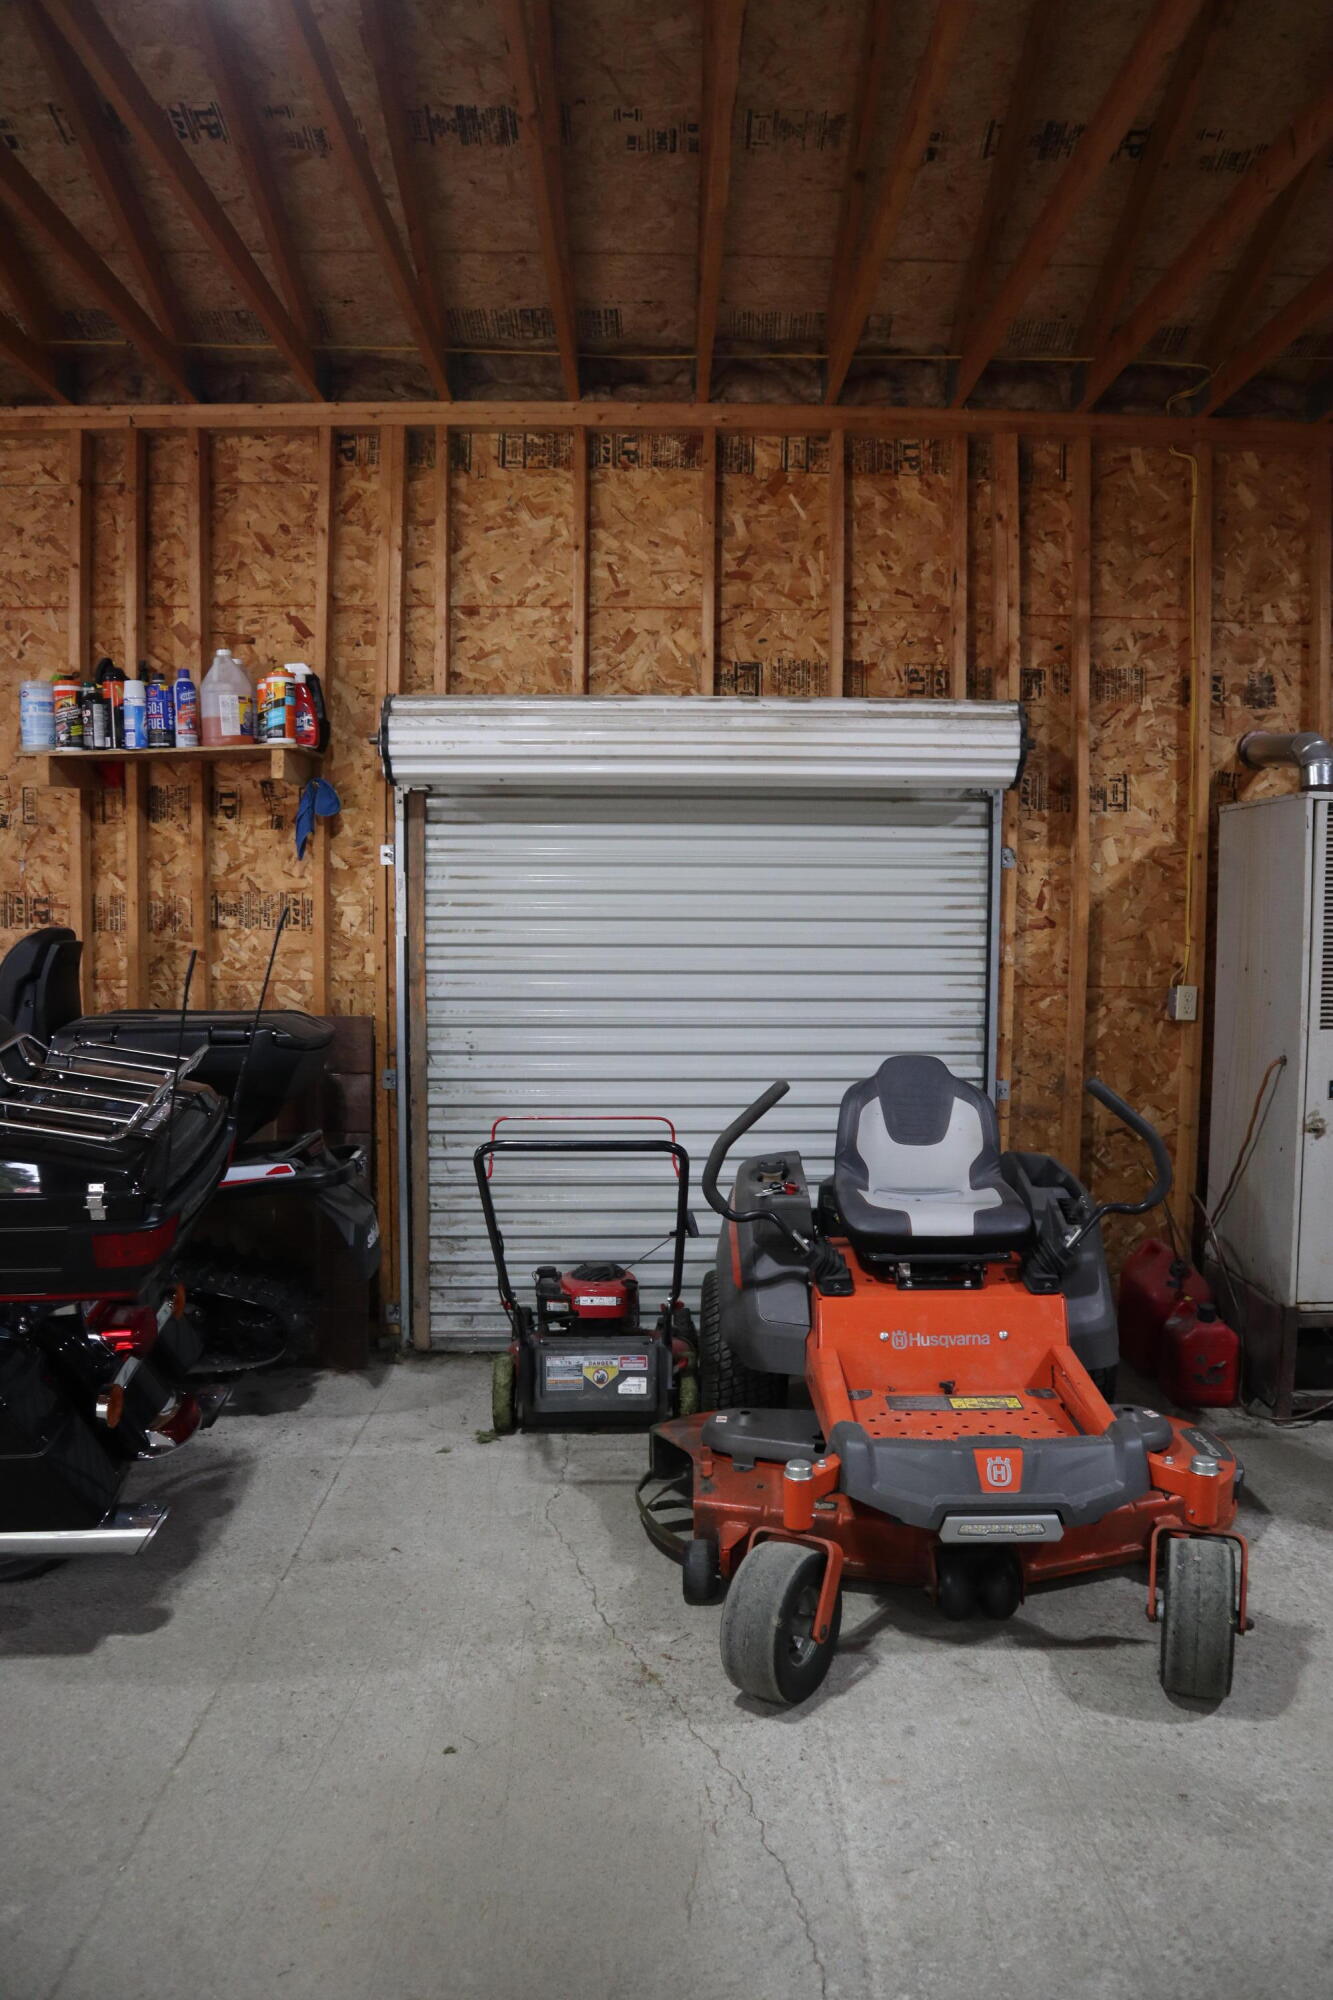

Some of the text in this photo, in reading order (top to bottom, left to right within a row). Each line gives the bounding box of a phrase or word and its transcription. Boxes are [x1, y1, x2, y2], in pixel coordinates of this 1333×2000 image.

[148, 718, 166, 730] FUEL
[220, 791, 237, 819] LP
[291, 897, 300, 925] APA
[909, 1332, 991, 1348] Husqvarna
